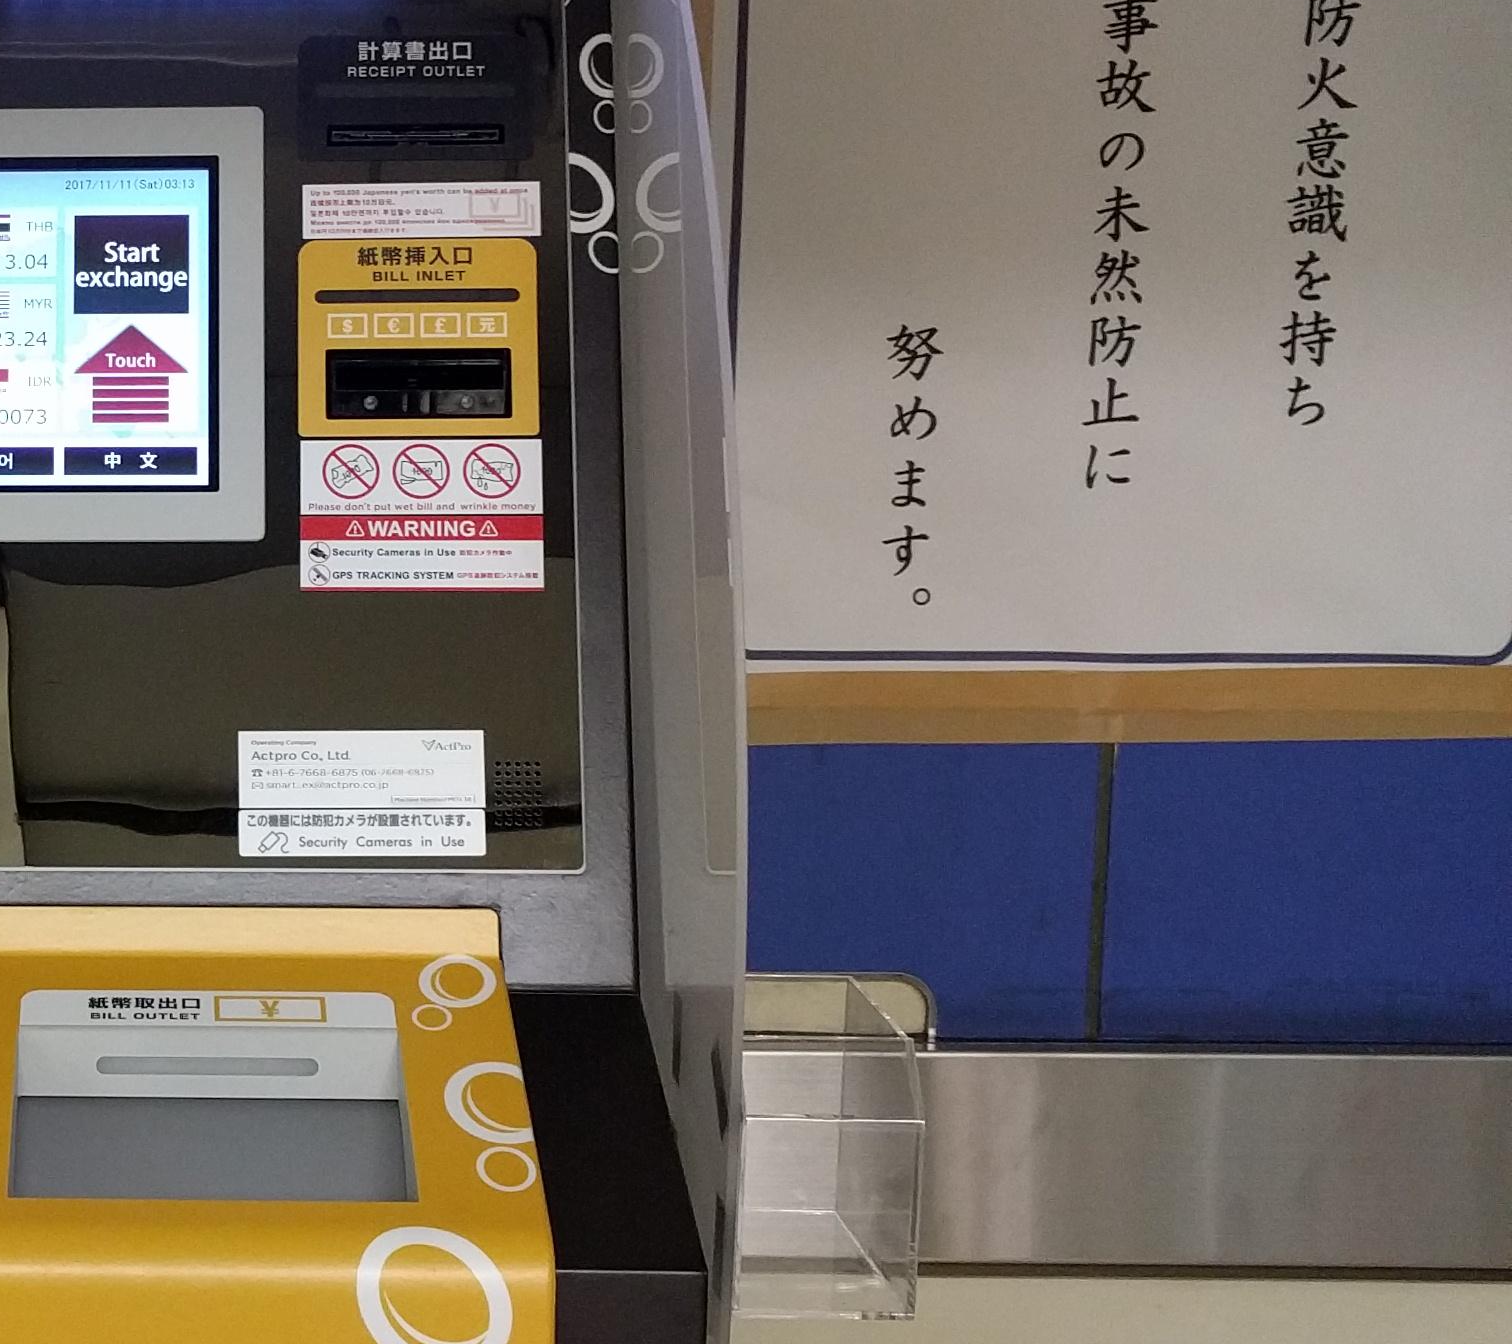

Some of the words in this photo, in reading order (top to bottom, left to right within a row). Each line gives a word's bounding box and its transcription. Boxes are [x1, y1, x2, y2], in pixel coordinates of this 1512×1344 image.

[357, 41, 474, 62] 計算書出口
[347, 66, 416, 78] RECEIPT
[422, 65, 486, 78] OUTLET
[103, 241, 160, 264] Start
[356, 245, 474, 267] 紙幣挿入口
[4, 254, 48, 270] 3.04
[75, 266, 188, 292] exchange
[372, 270, 409, 282] BILL
[416, 270, 467, 282] INLET
[23, 298, 53, 310] MYR
[104, 352, 157, 369] Touch
[27, 376, 53, 387] IDR
[882, 321, 945, 610] 努めます。
[308, 502, 341, 511] Please
[344, 502, 371, 511] don't
[374, 503, 391, 512] put
[395, 503, 413, 511] wet
[417, 502, 432, 511] bill
[436, 502, 455, 511] and
[460, 502, 498, 511] wrinkle
[501, 503, 536, 513] money
[368, 520, 476, 538] WARNING
[332, 548, 374, 558] Security
[376, 548, 421, 557] Cameras
[437, 547, 456, 556] Use
[332, 571, 353, 580] GPS
[357, 571, 410, 580] TRACKING
[413, 571, 454, 580] SYSTEM
[251, 751, 297, 763] Actpro
[327, 750, 351, 761] Ltd.
[298, 836, 348, 849] Security
[356, 836, 413, 848] Cameras
[420, 835, 433, 848] in
[440, 835, 465, 848] Use
[88, 996, 202, 1010] 紙幣取出口
[90, 1012, 127, 1020] BILL
[133, 1012, 201, 1021] OUTLET
